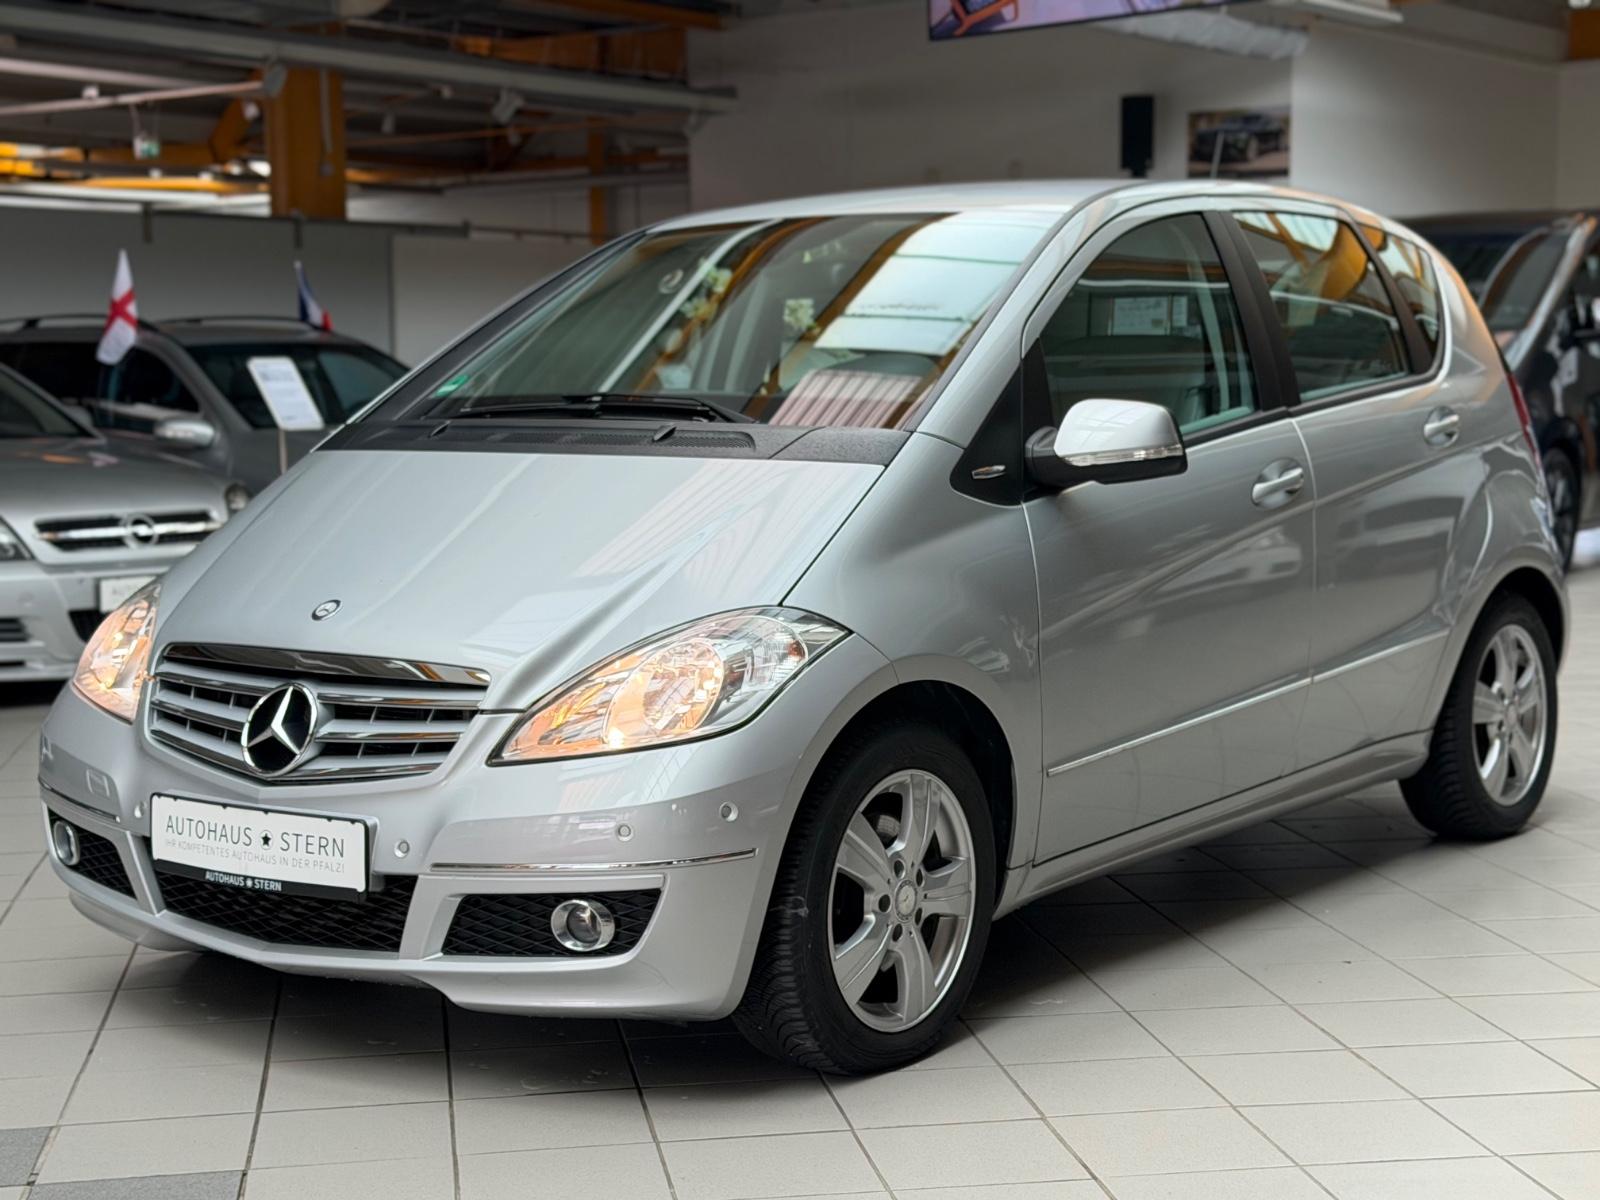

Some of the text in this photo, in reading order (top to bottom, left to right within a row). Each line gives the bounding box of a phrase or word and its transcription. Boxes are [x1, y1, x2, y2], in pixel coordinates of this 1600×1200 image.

[166, 815, 344, 858] AUTOHAUS STERN
[232, 850, 277, 865] AUTOHAUS
[279, 856, 289, 866] IN
[292, 857, 311, 869] DER
[205, 870, 282, 892] AUTOHAUS STERN
